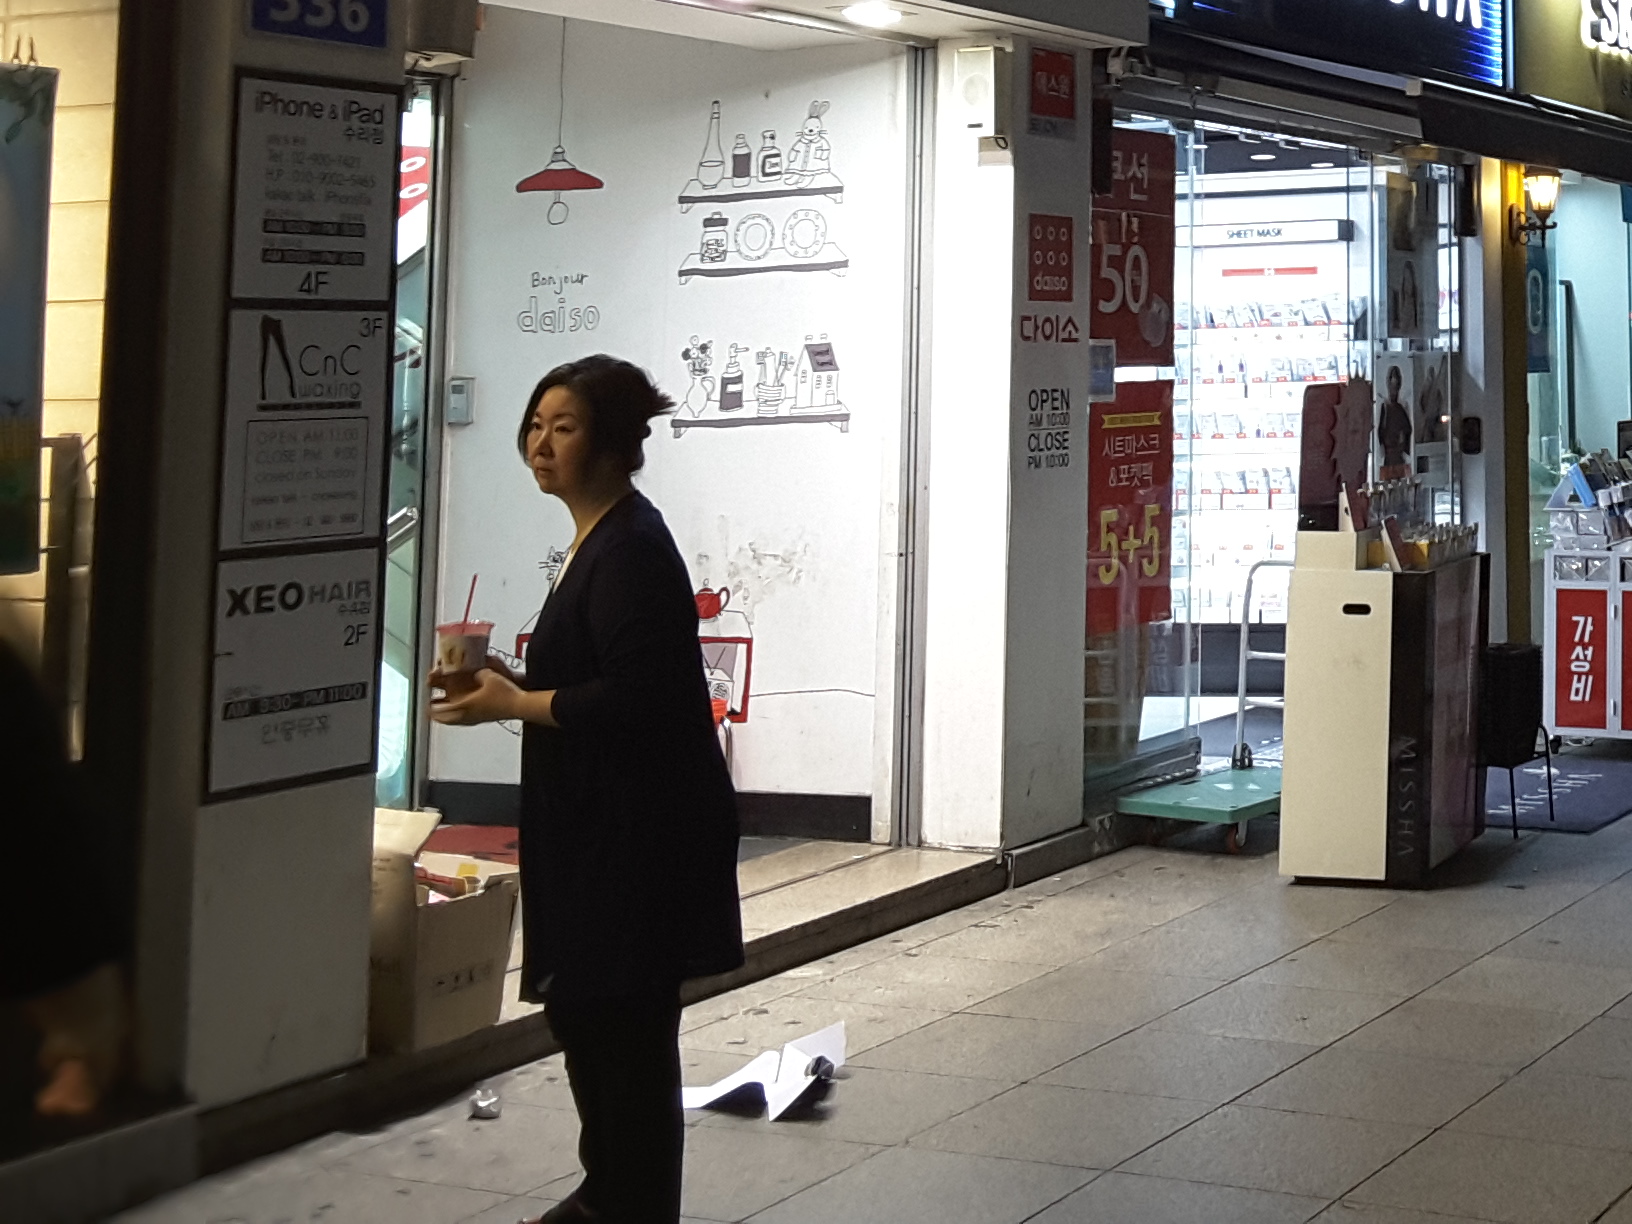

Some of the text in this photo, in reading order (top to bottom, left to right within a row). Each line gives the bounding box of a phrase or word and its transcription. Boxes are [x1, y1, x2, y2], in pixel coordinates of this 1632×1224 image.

[256, 90, 325, 119] iPhone
[342, 98, 385, 125] iPad
[1226, 228, 1283, 239] SHEET MASK
[297, 270, 330, 296] 4F
[530, 270, 589, 290] Bonjour
[1032, 271, 1070, 293] daiso
[1098, 244, 1151, 315] 50
[359, 316, 384, 338] 3F
[516, 296, 601, 335] daiso
[1020, 314, 1081, 344] 다이소
[299, 343, 362, 377] CnC
[298, 380, 362, 400] waxing
[1027, 387, 1071, 412] OPEN
[1027, 411, 1071, 429] AM 10:00
[1027, 428, 1070, 454] CLOSE
[1102, 432, 1161, 459] 시트마스크
[1027, 452, 1070, 470] PM 10:00
[1097, 494, 1162, 584] 5+5
[225, 581, 305, 618] XEO
[308, 579, 372, 604] HAIR
[343, 622, 369, 647] 2F
[1569, 615, 1594, 702] 가성비
[226, 701, 250, 719] AM
[302, 689, 326, 708] PM
[1396, 736, 1419, 859] MISSHA
